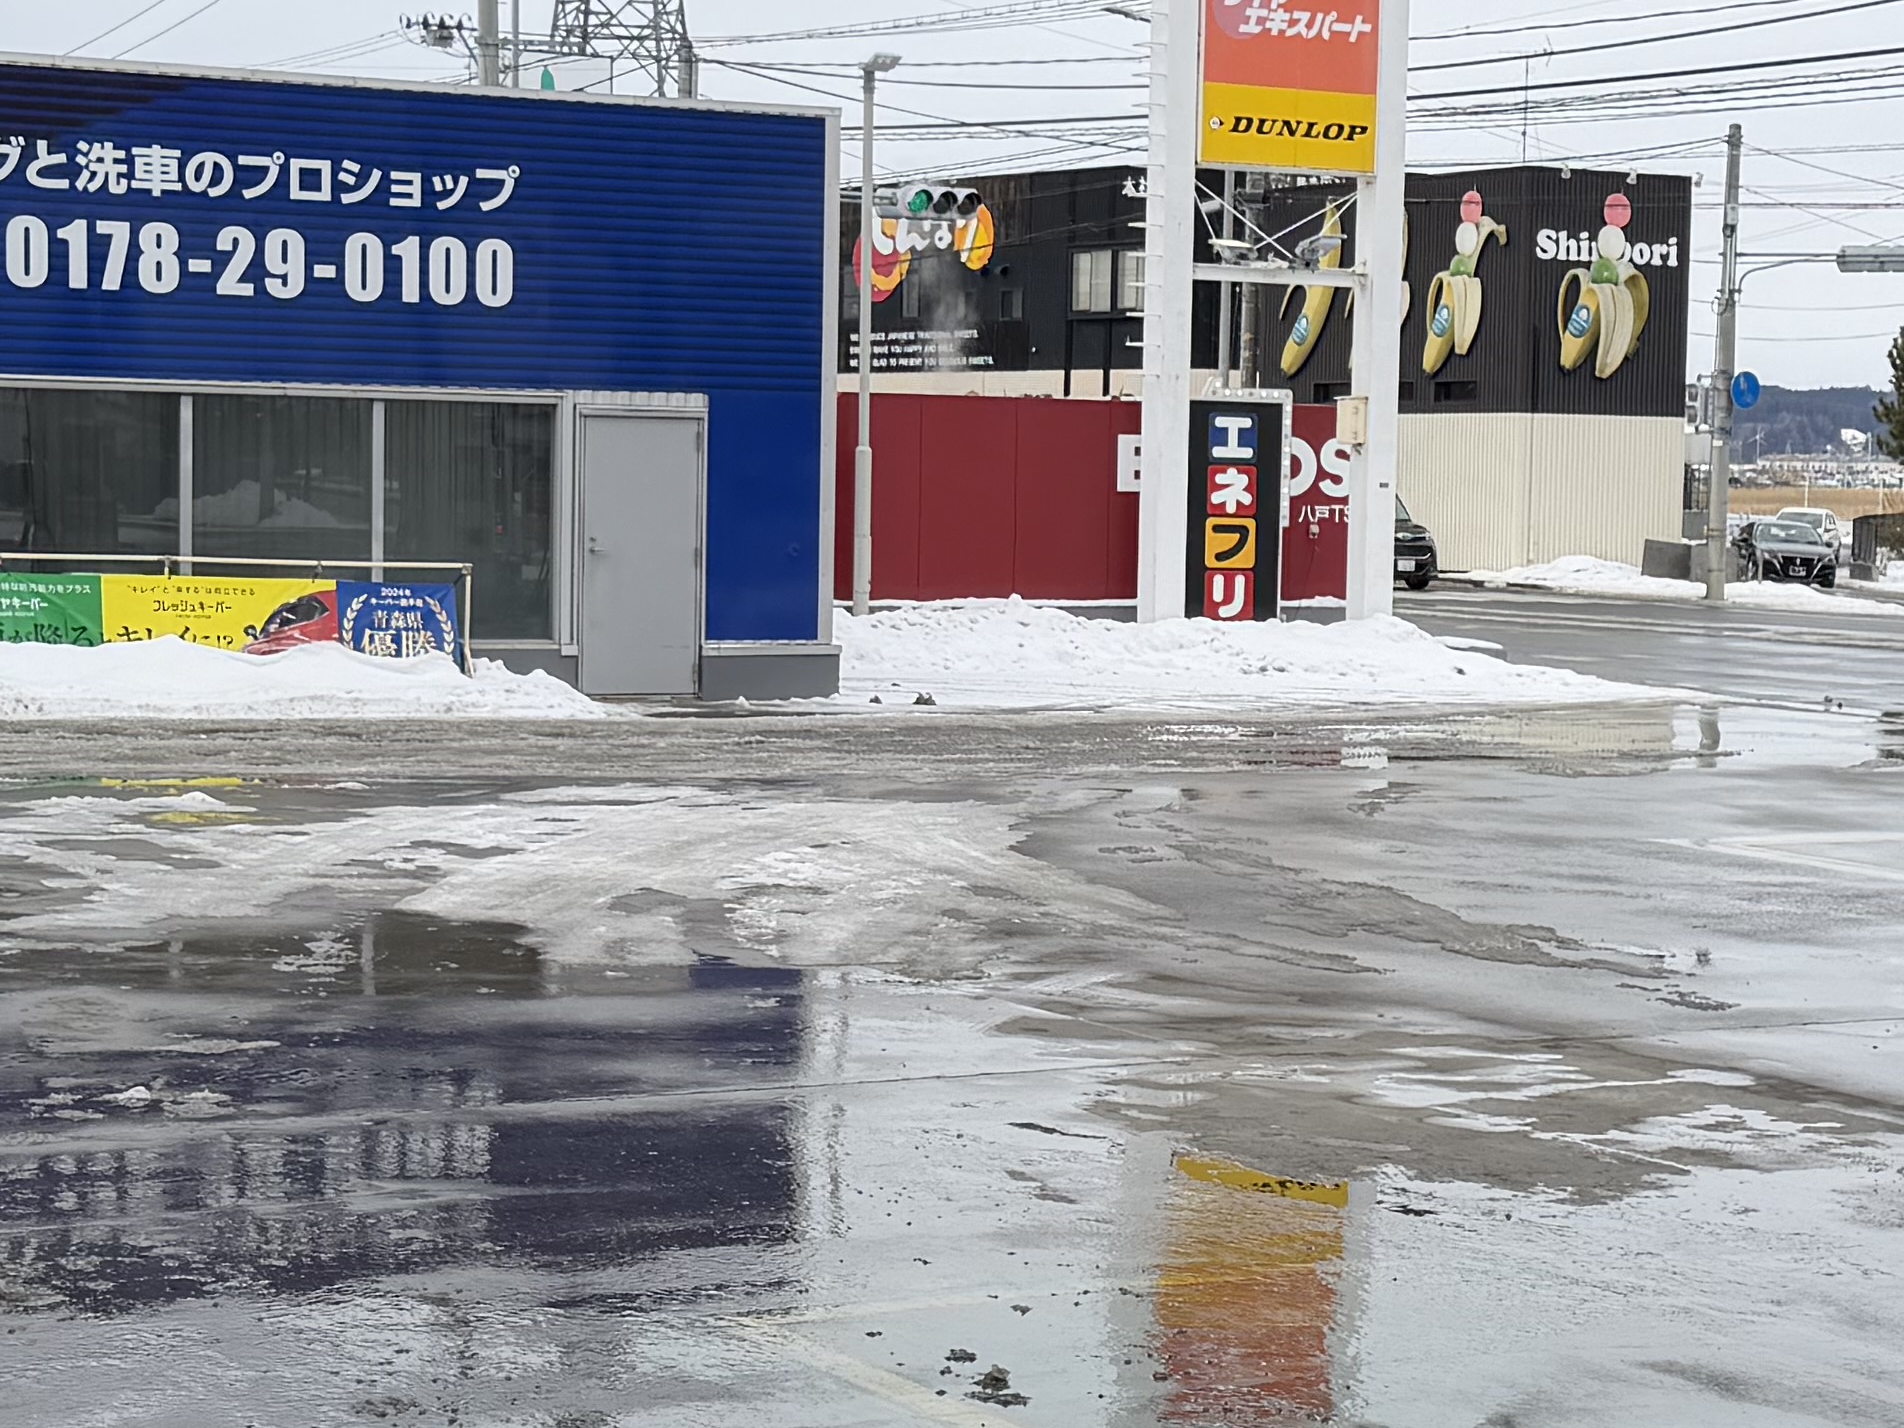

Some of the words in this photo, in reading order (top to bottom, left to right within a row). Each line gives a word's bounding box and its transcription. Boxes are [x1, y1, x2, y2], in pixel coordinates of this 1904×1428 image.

[1238, 7, 1373, 44] エキスパート
[1228, 115, 1369, 142] DUNLOP
[4, 214, 517, 308] 0178-29-0100
[1210, 415, 1254, 619] エネフリ
